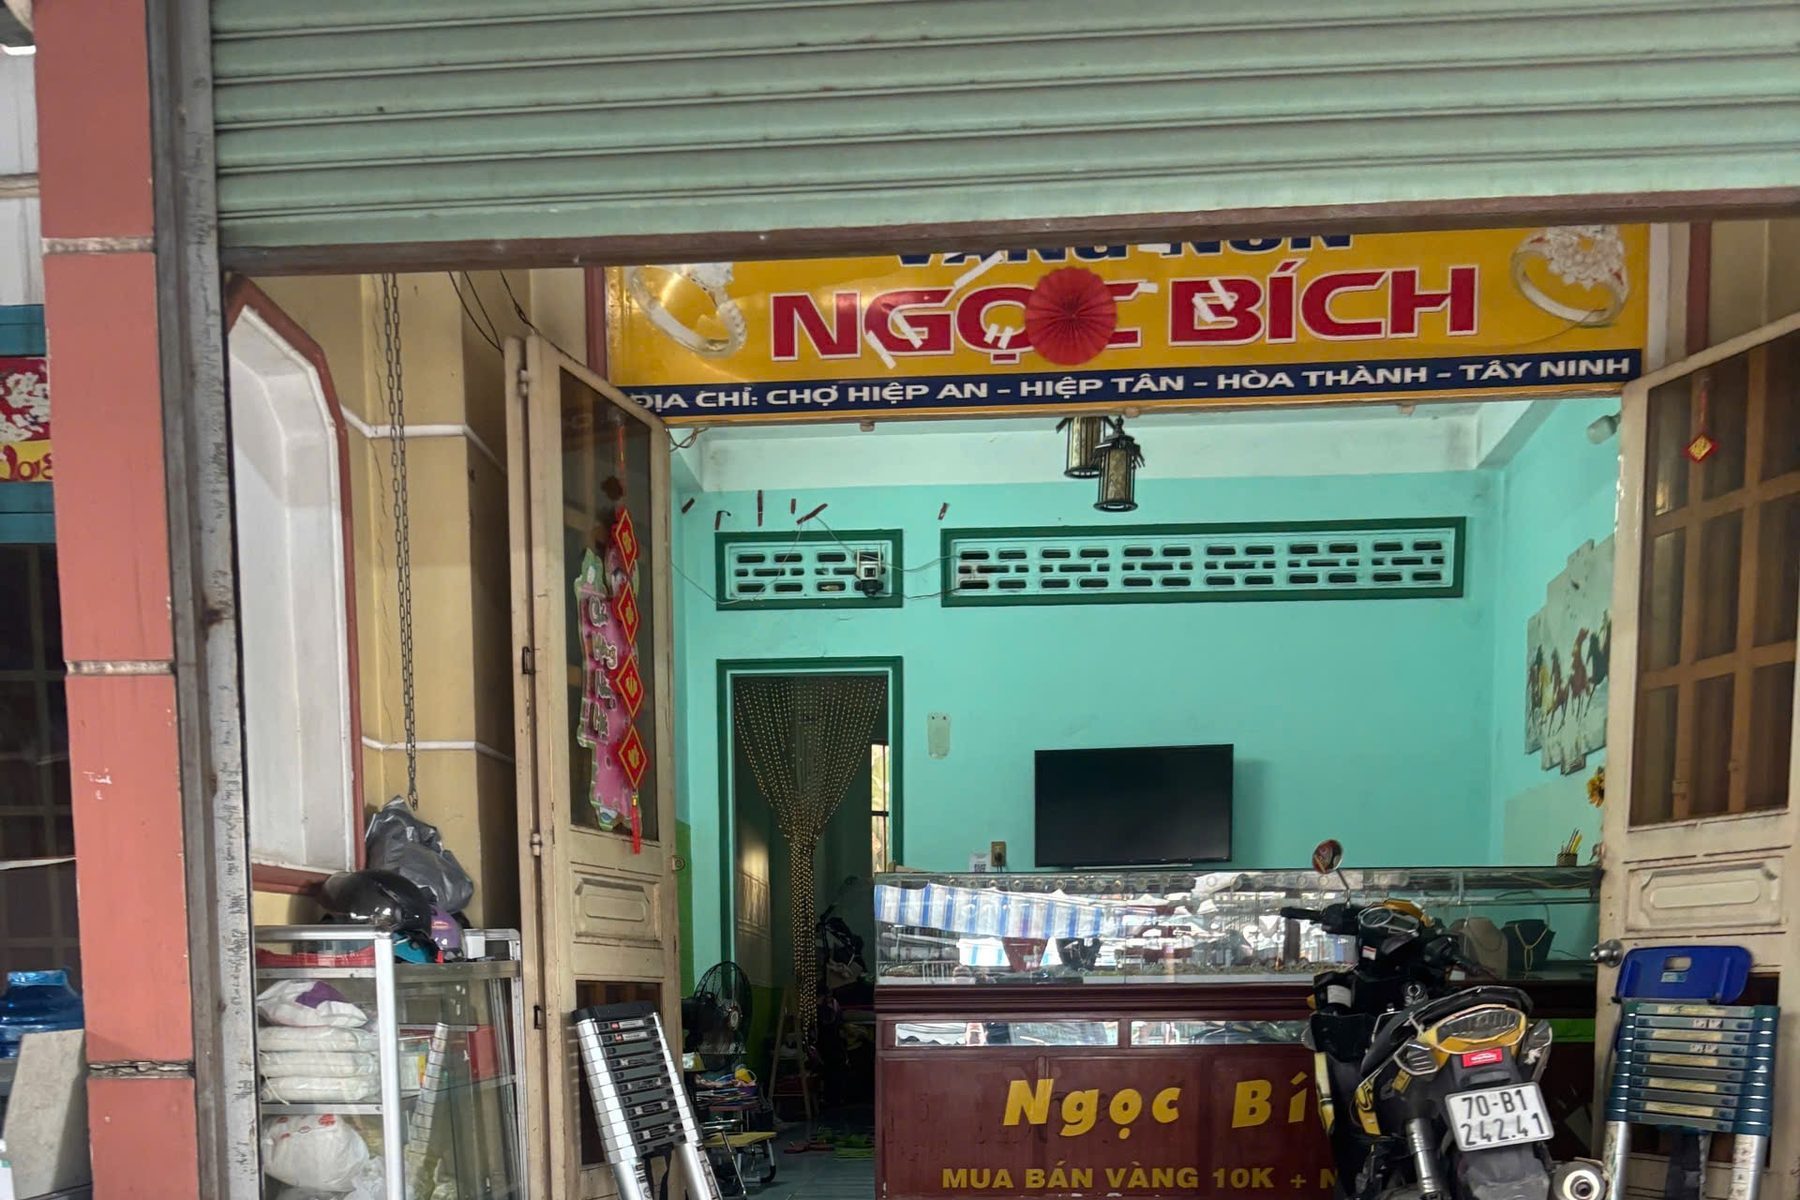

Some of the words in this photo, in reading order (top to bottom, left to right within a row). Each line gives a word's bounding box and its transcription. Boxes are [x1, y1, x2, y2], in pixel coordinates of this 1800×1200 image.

[1168, 257, 1479, 347] BÍCH
[766, 384, 838, 407] CHỢ
[847, 382, 929, 404] HIỆP
[936, 382, 988, 400] AN
[1019, 376, 1103, 399] HIỆP
[1110, 373, 1185, 394] TÂN
[1217, 370, 1295, 391] HÒA
[1301, 364, 1428, 387] THÀNH
[1459, 360, 1532, 381] TÂY
[1539, 357, 1631, 378] NINH
[1003, 1078, 1182, 1140] Ngọc
[1462, 1089, 1527, 1119] 70-B1
[1460, 1112, 1545, 1146] 242.41
[942, 1168, 1017, 1189] MUA
[1024, 1160, 1093, 1189] BÁN
[1105, 1161, 1199, 1189] VÀNG
[1212, 1167, 1275, 1189] 10K
